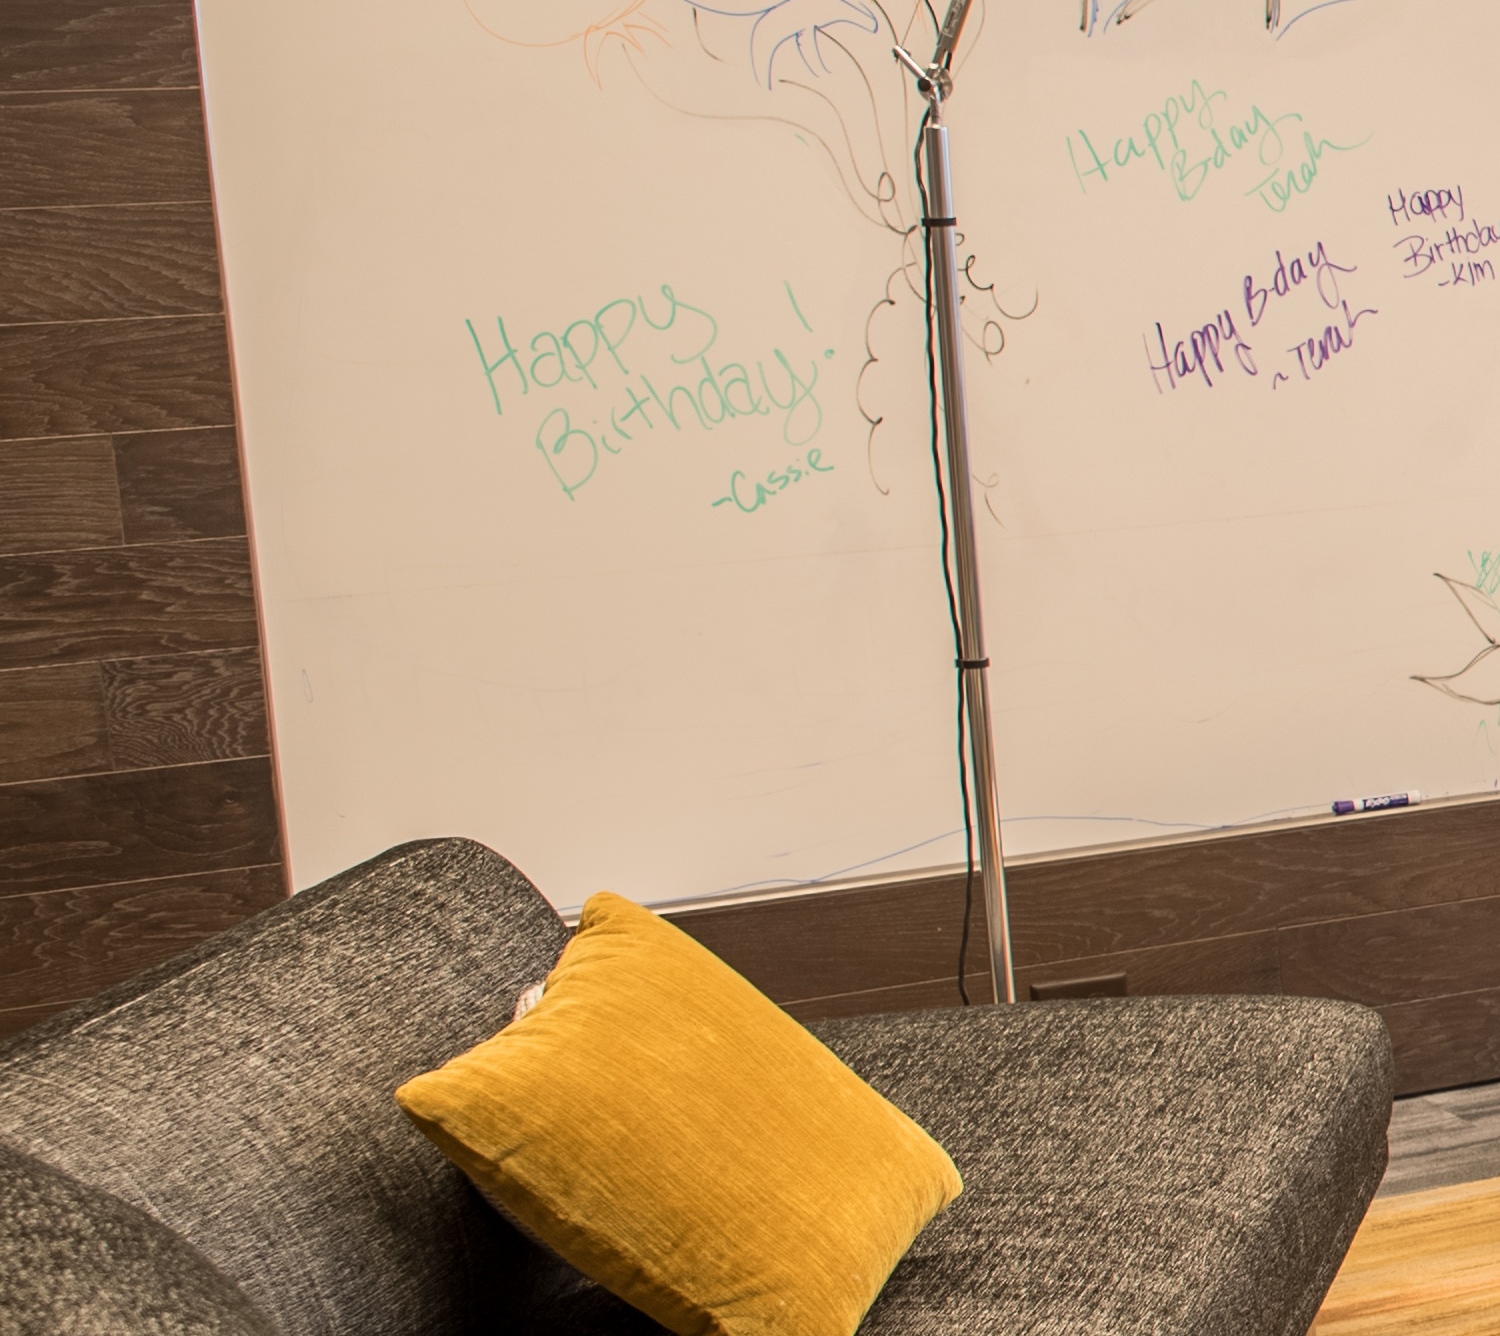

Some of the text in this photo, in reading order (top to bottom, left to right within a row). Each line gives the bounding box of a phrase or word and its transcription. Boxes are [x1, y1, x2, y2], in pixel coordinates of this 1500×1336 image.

[1067, 79, 1227, 195] Happy
[1388, 185, 1465, 225] Happy
[466, 285, 716, 414] Happy
[536, 280, 835, 500] Birthday!
[1143, 310, 1258, 393] Happy
